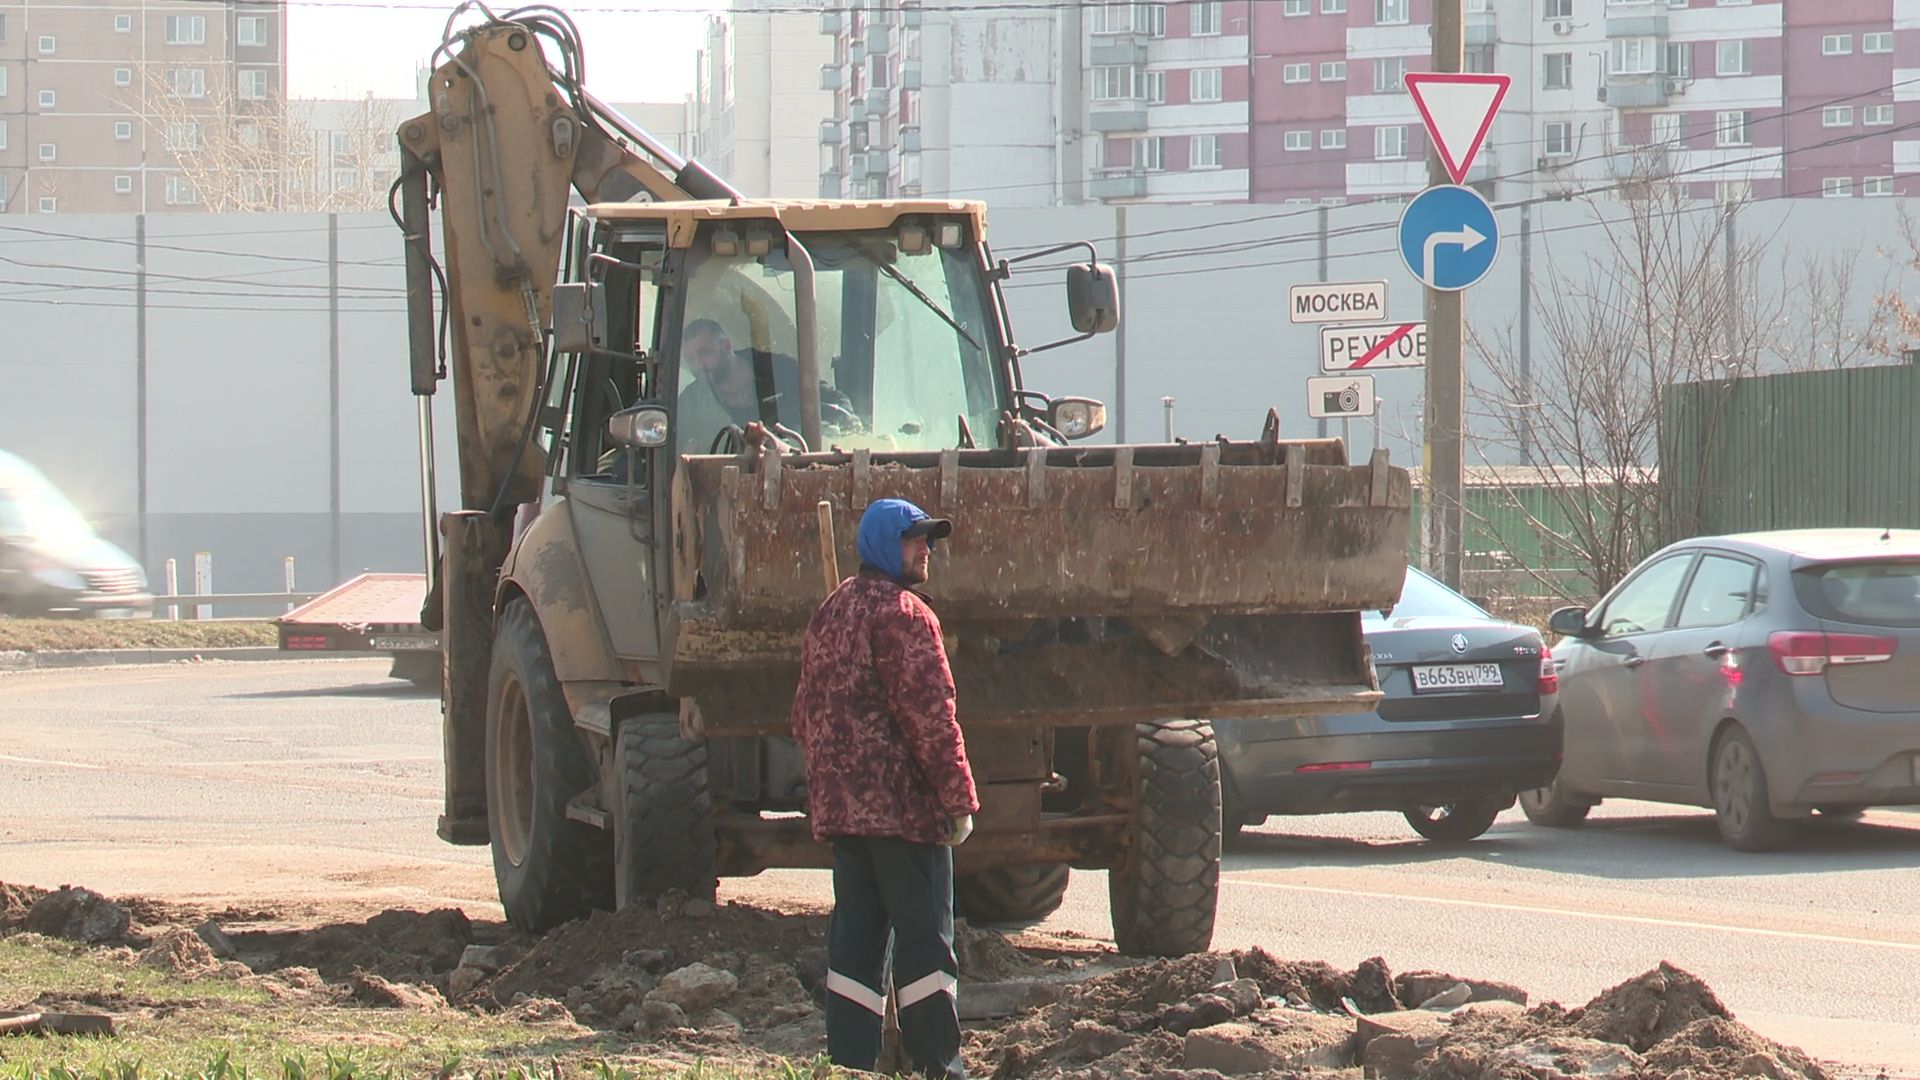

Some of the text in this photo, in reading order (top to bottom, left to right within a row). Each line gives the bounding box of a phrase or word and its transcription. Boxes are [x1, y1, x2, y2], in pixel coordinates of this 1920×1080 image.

[1296, 292, 1379, 314] МОСКВА
[1418, 664, 1498, 686] В663ВН 799
